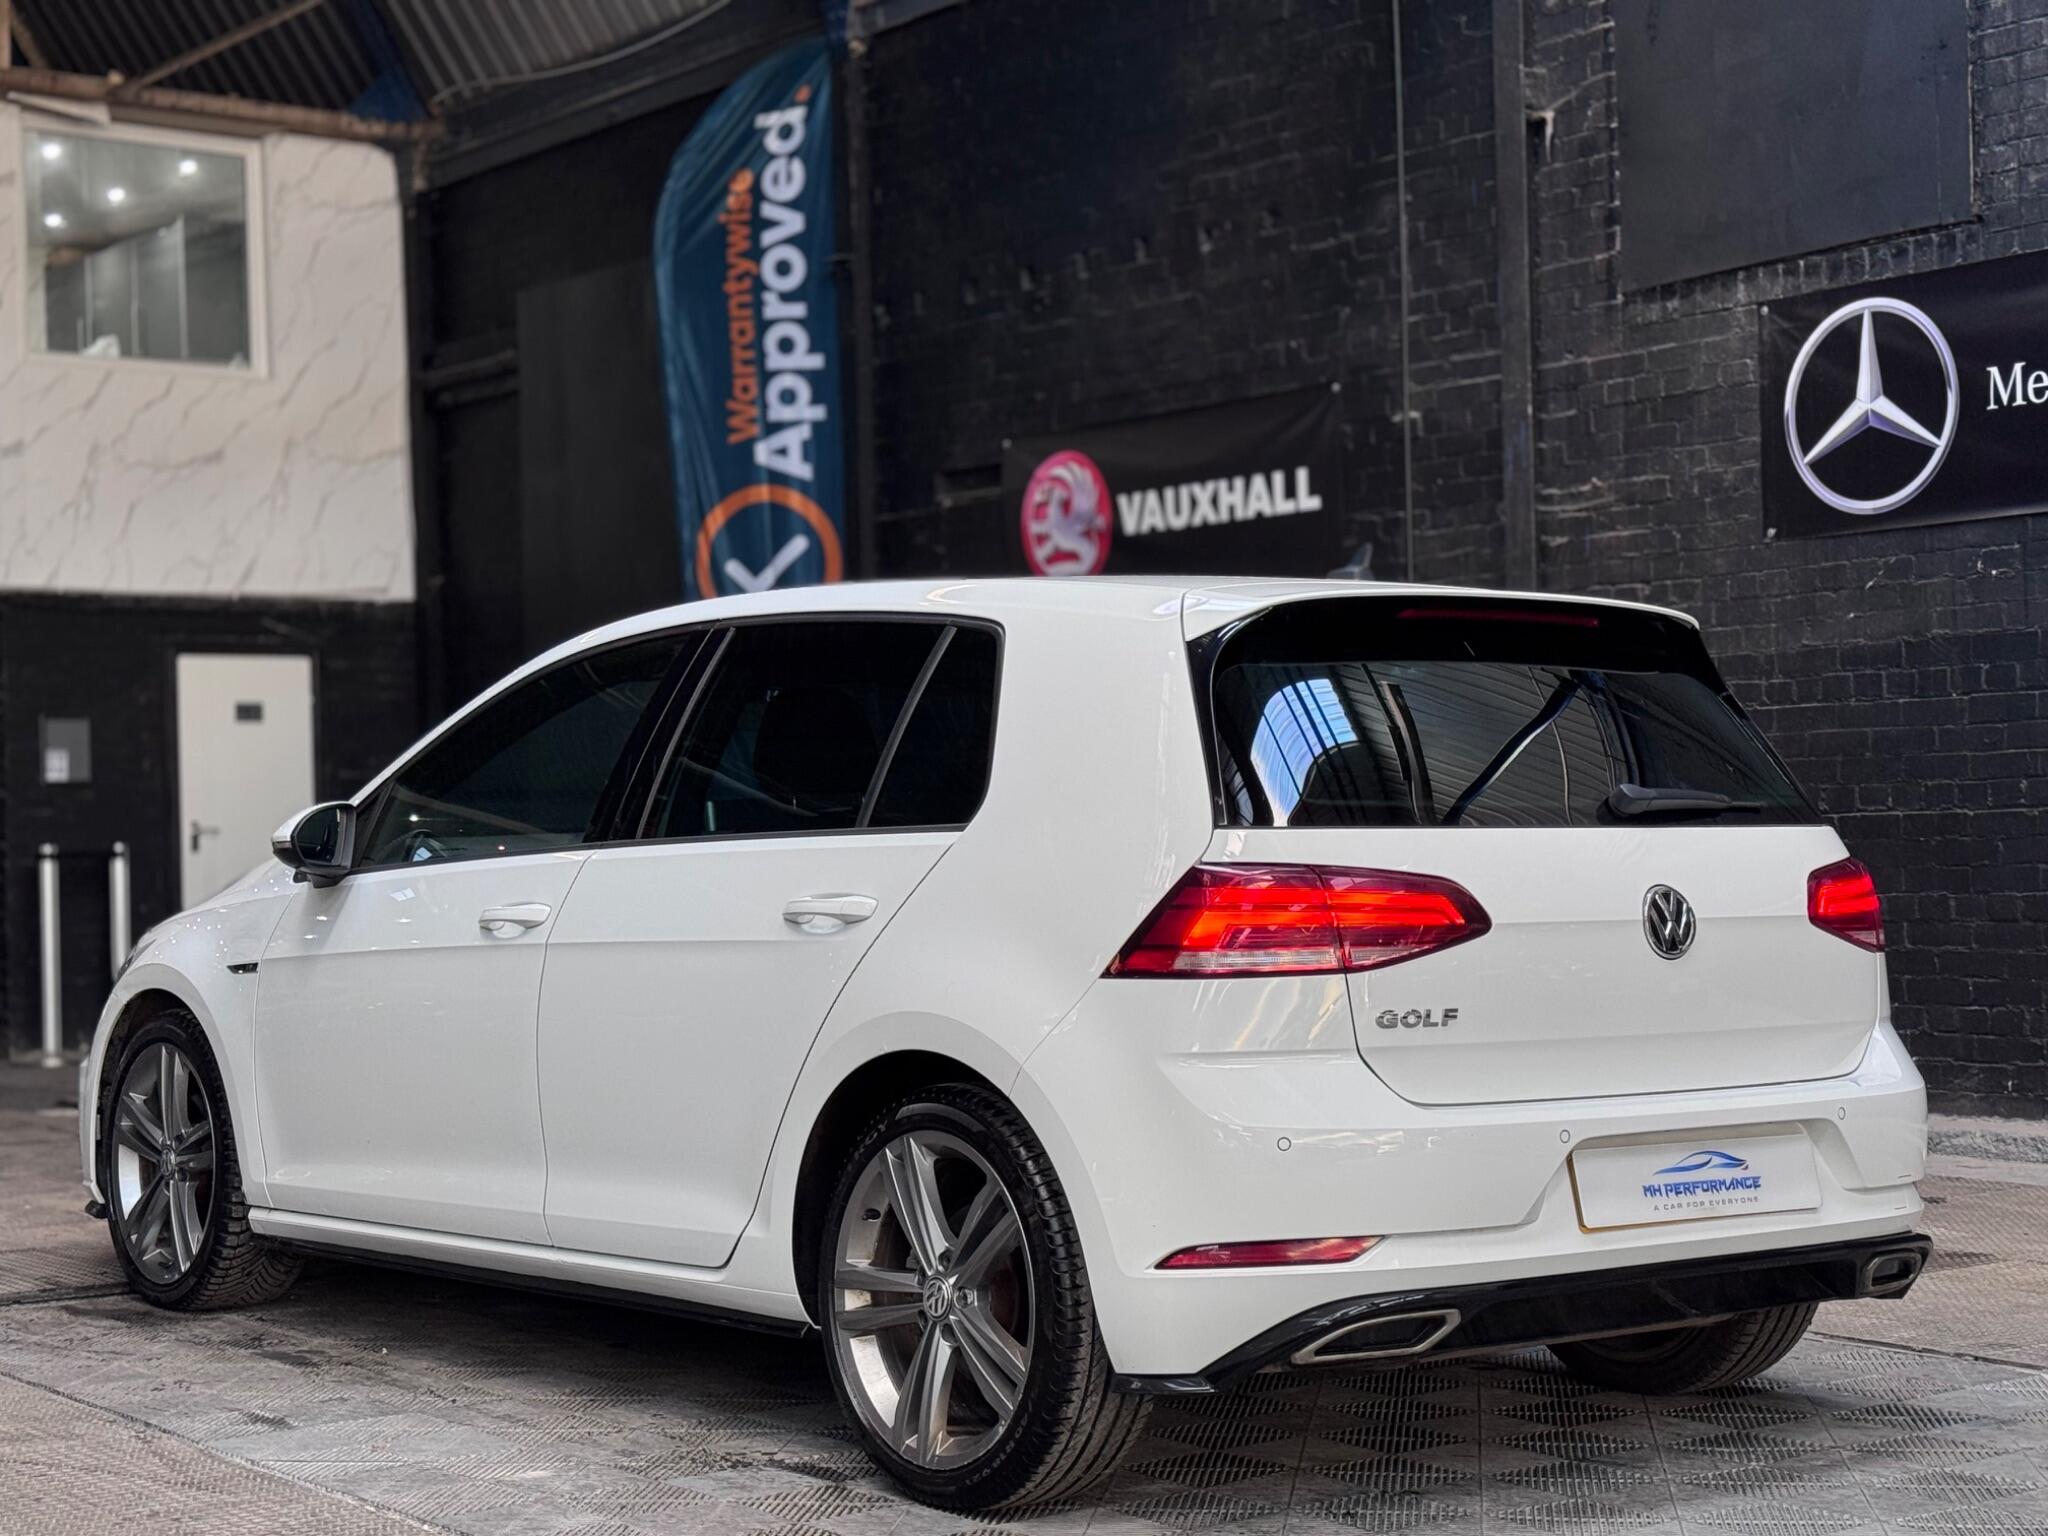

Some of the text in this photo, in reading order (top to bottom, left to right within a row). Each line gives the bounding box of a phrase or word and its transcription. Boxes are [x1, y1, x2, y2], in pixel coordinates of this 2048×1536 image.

[718, 168, 760, 445] Warrantywise
[1116, 465, 1323, 537] VAUXHALL
[1375, 1007, 1459, 1029] GOLF
[1642, 1176, 1761, 1198] MH PERFORMANCE
[1663, 1202, 1683, 1211] CAR
[1686, 1200, 1706, 1208] FOR
[1709, 1196, 1759, 1207] EVERYONE
